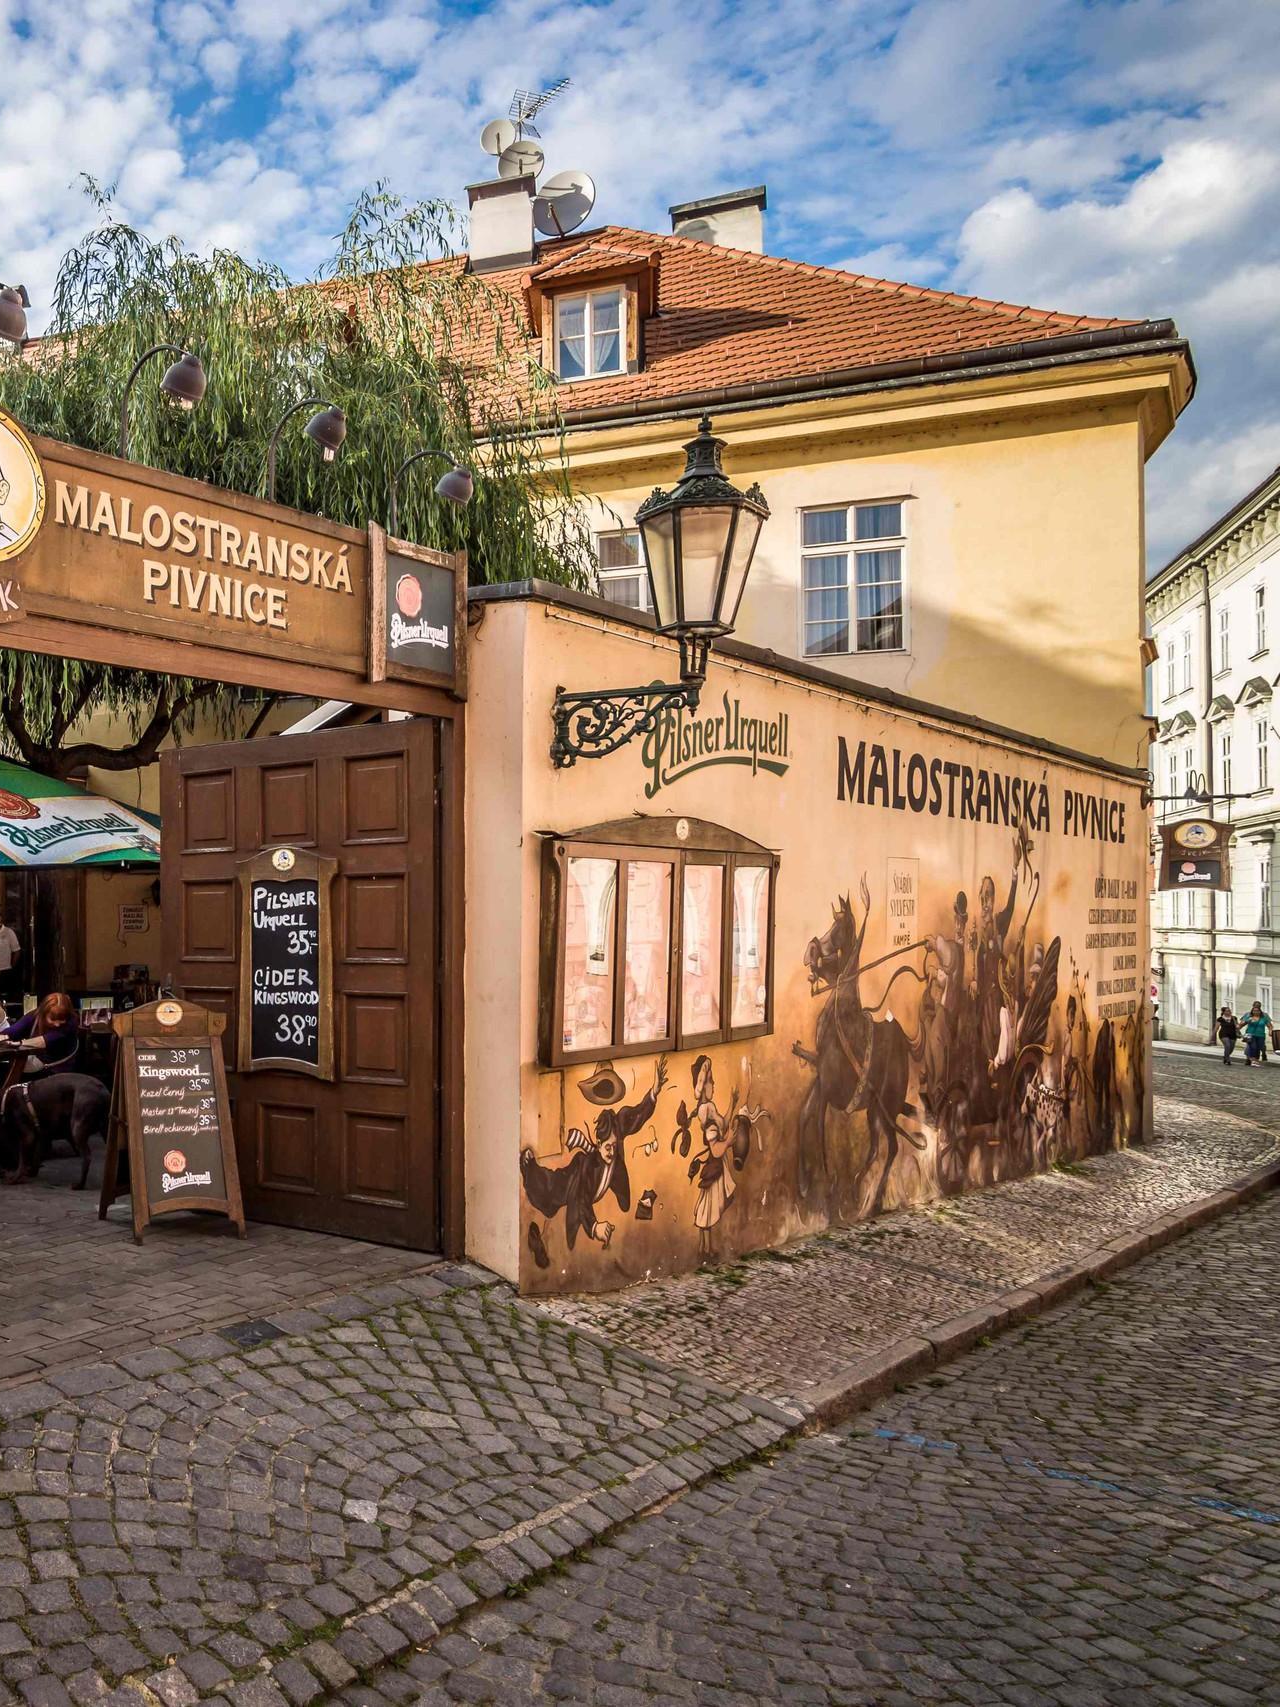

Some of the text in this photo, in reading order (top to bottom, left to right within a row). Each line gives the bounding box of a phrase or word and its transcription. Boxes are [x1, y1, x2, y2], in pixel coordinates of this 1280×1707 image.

[53, 479, 355, 594] MALOSTRANSKÁ
[141, 557, 290, 630] PIVNICE
[836, 735, 1127, 844] MALOSTRANSKÁ PIVNICE
[138, 1064, 200, 1082] Kingswood
